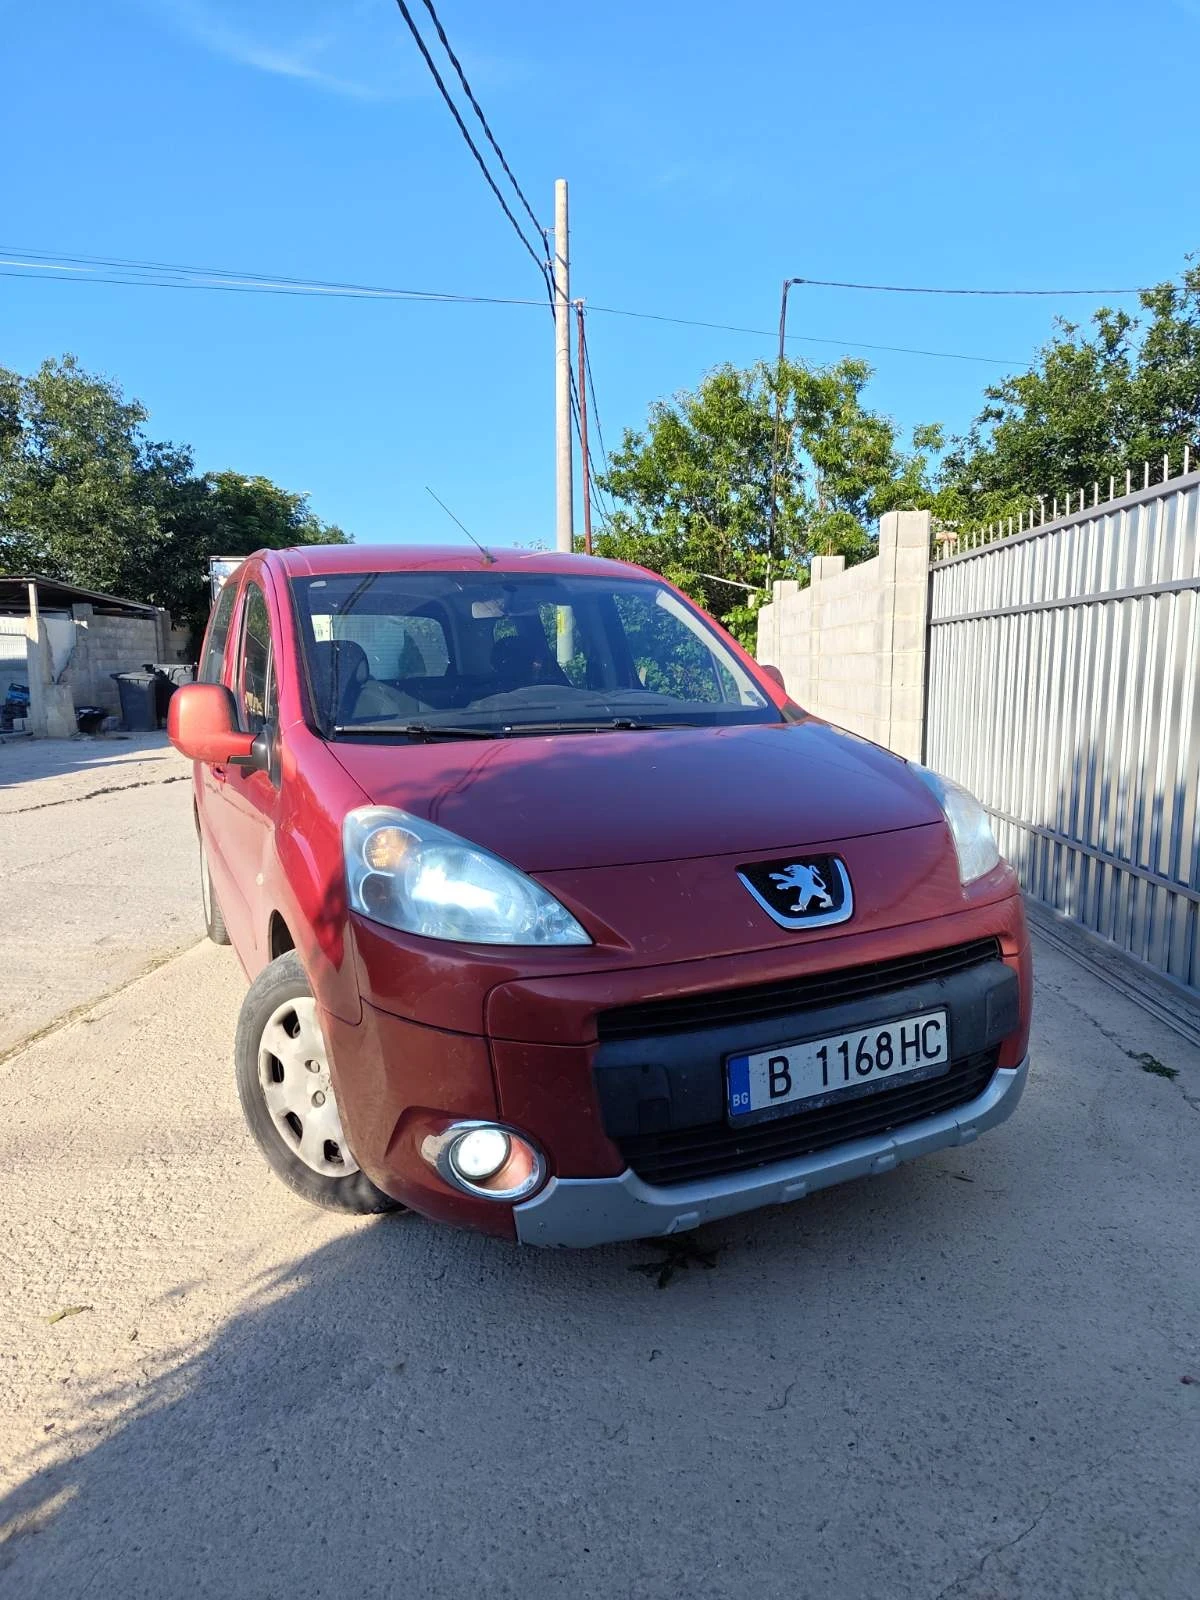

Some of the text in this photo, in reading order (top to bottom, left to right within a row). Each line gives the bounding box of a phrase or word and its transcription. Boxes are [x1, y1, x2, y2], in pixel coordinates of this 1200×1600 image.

[768, 1055, 792, 1099] B
[816, 1031, 894, 1086] 1168
[732, 1091, 749, 1107] BG
